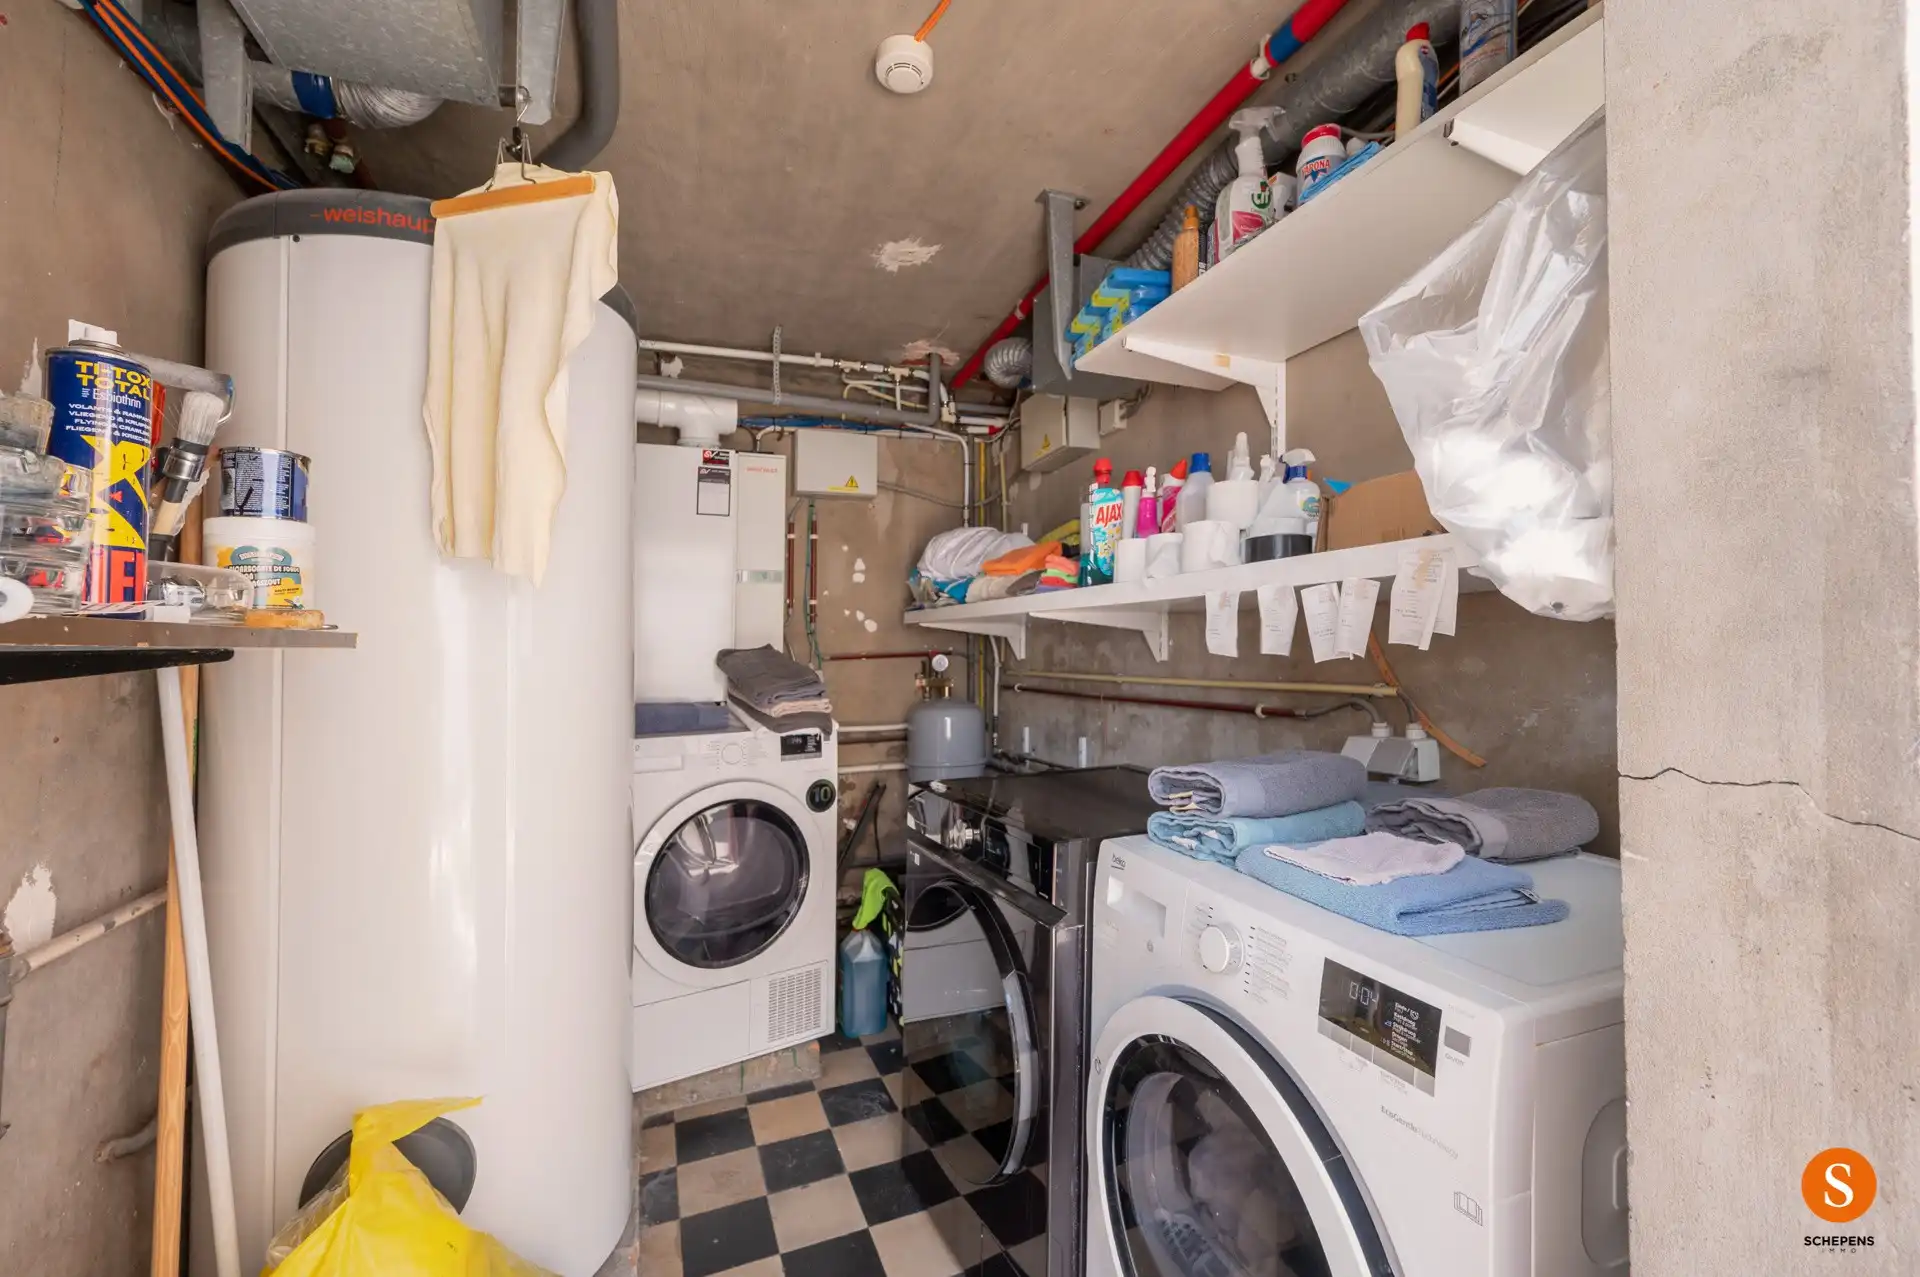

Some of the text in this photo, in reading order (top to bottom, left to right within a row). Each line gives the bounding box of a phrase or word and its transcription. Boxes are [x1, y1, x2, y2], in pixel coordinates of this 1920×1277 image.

[324, 206, 435, 234] weishaup
[76, 374, 150, 401] TOTAL
[1096, 502, 1122, 527] AJAX
[813, 786, 831, 803] 10
